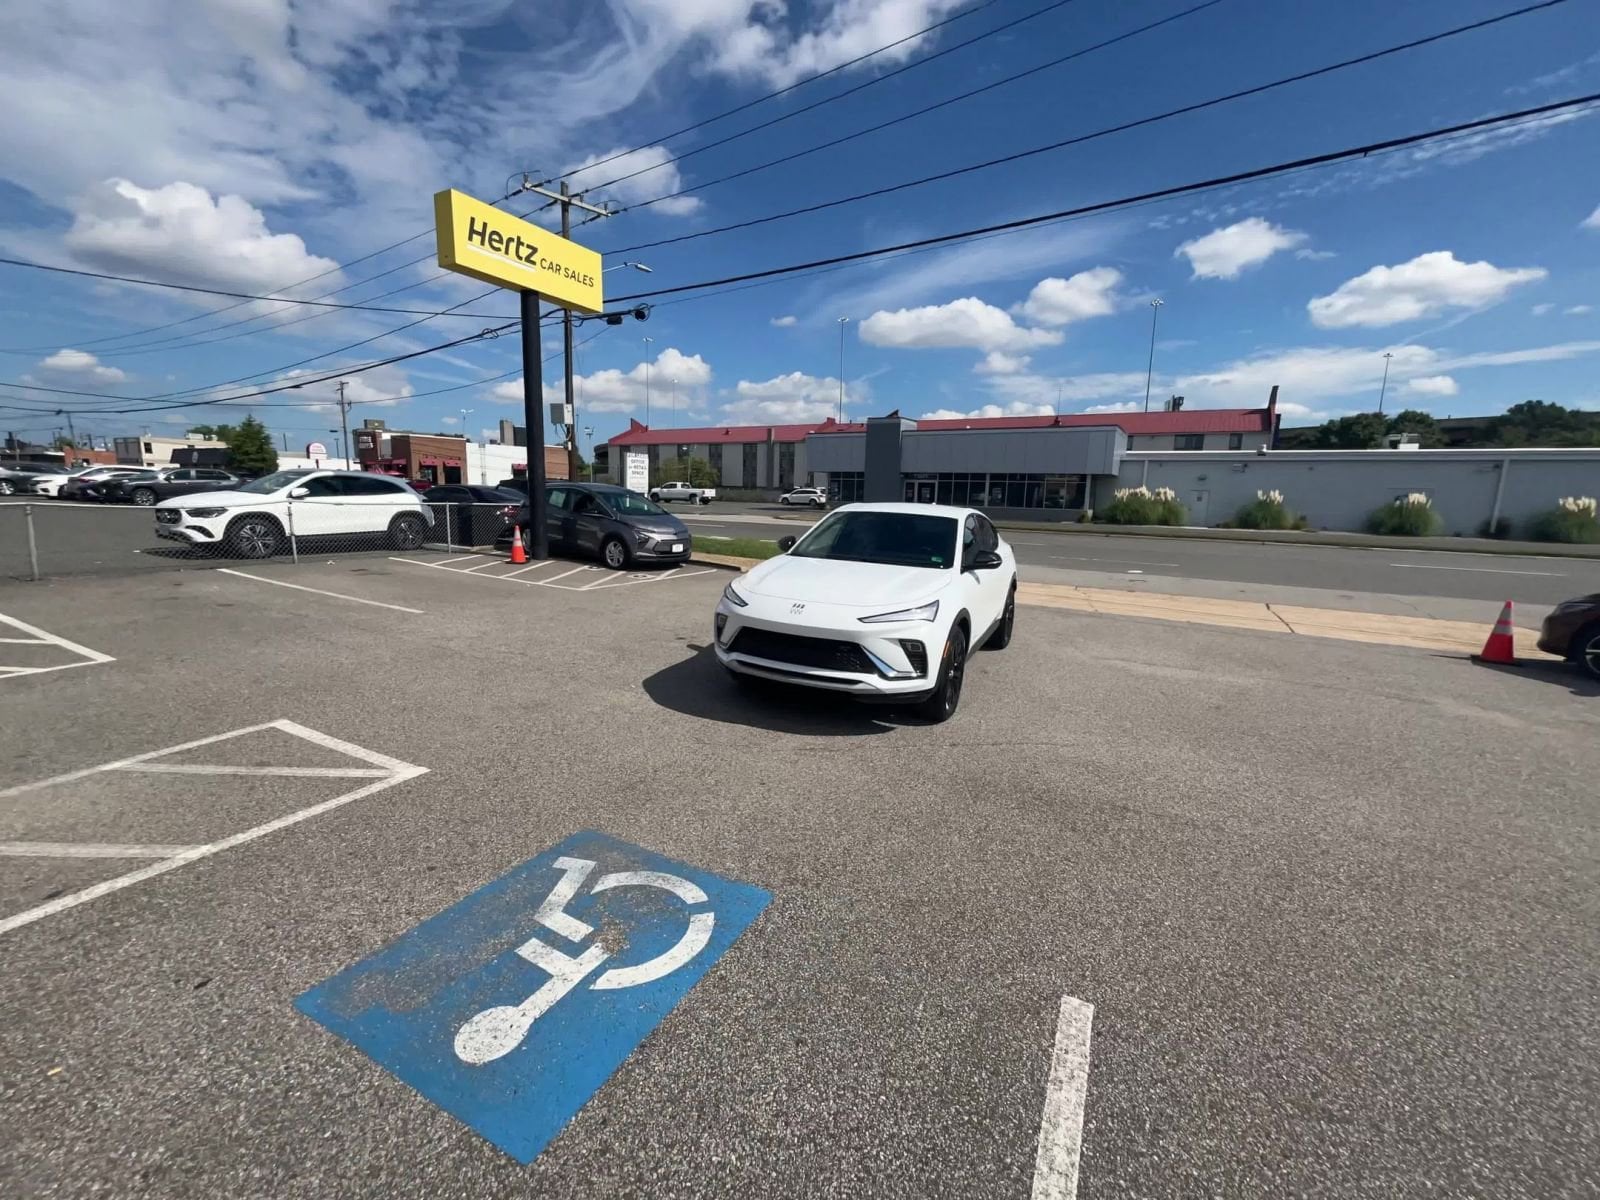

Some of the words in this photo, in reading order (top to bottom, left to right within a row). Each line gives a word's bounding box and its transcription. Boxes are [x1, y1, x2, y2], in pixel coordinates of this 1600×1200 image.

[467, 216, 538, 266] Hertz
[540, 258, 561, 276] CAR
[564, 267, 594, 288] SALES
